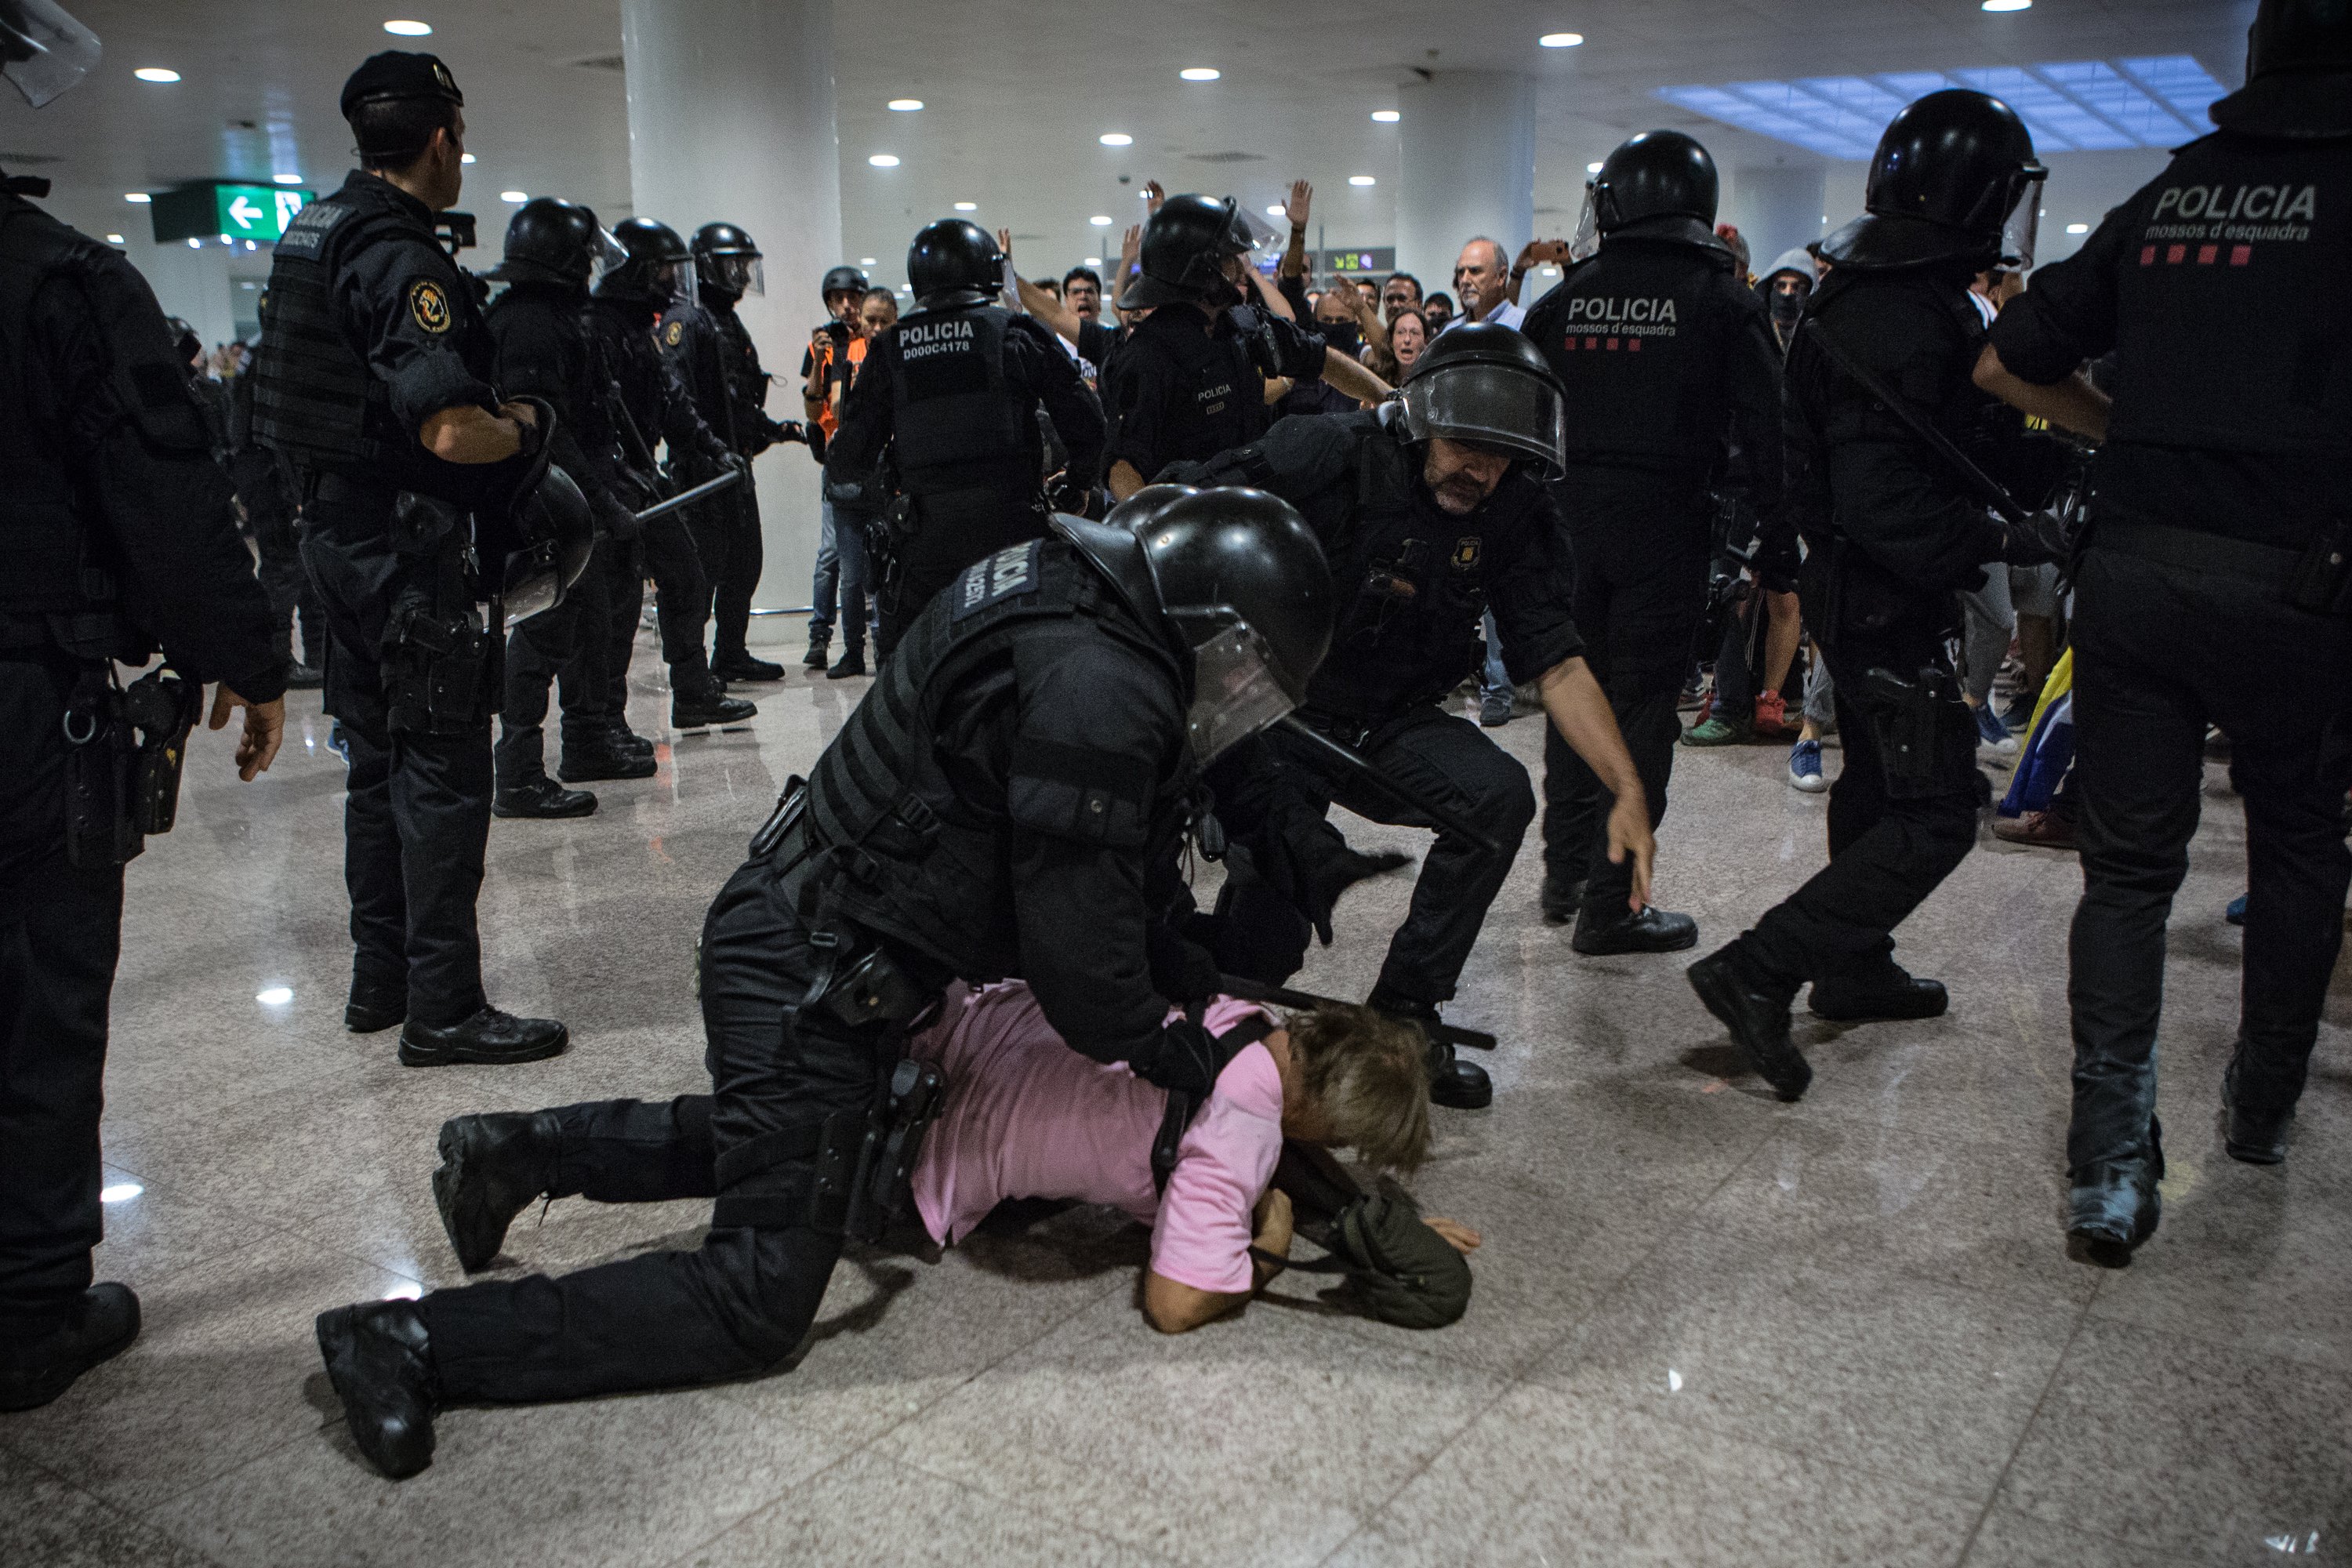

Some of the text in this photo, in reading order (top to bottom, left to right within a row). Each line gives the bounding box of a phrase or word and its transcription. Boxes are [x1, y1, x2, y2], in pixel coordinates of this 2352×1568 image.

[2153, 184, 2314, 220] POLICIA
[2145, 224, 2206, 241] mossos
[1568, 297, 1677, 322] POLICIA
[898, 320, 974, 347] POLICIA
[1566, 322, 1609, 335] mossos
[903, 340, 970, 361] D000C4178
[1198, 383, 1232, 401] POLICIA
